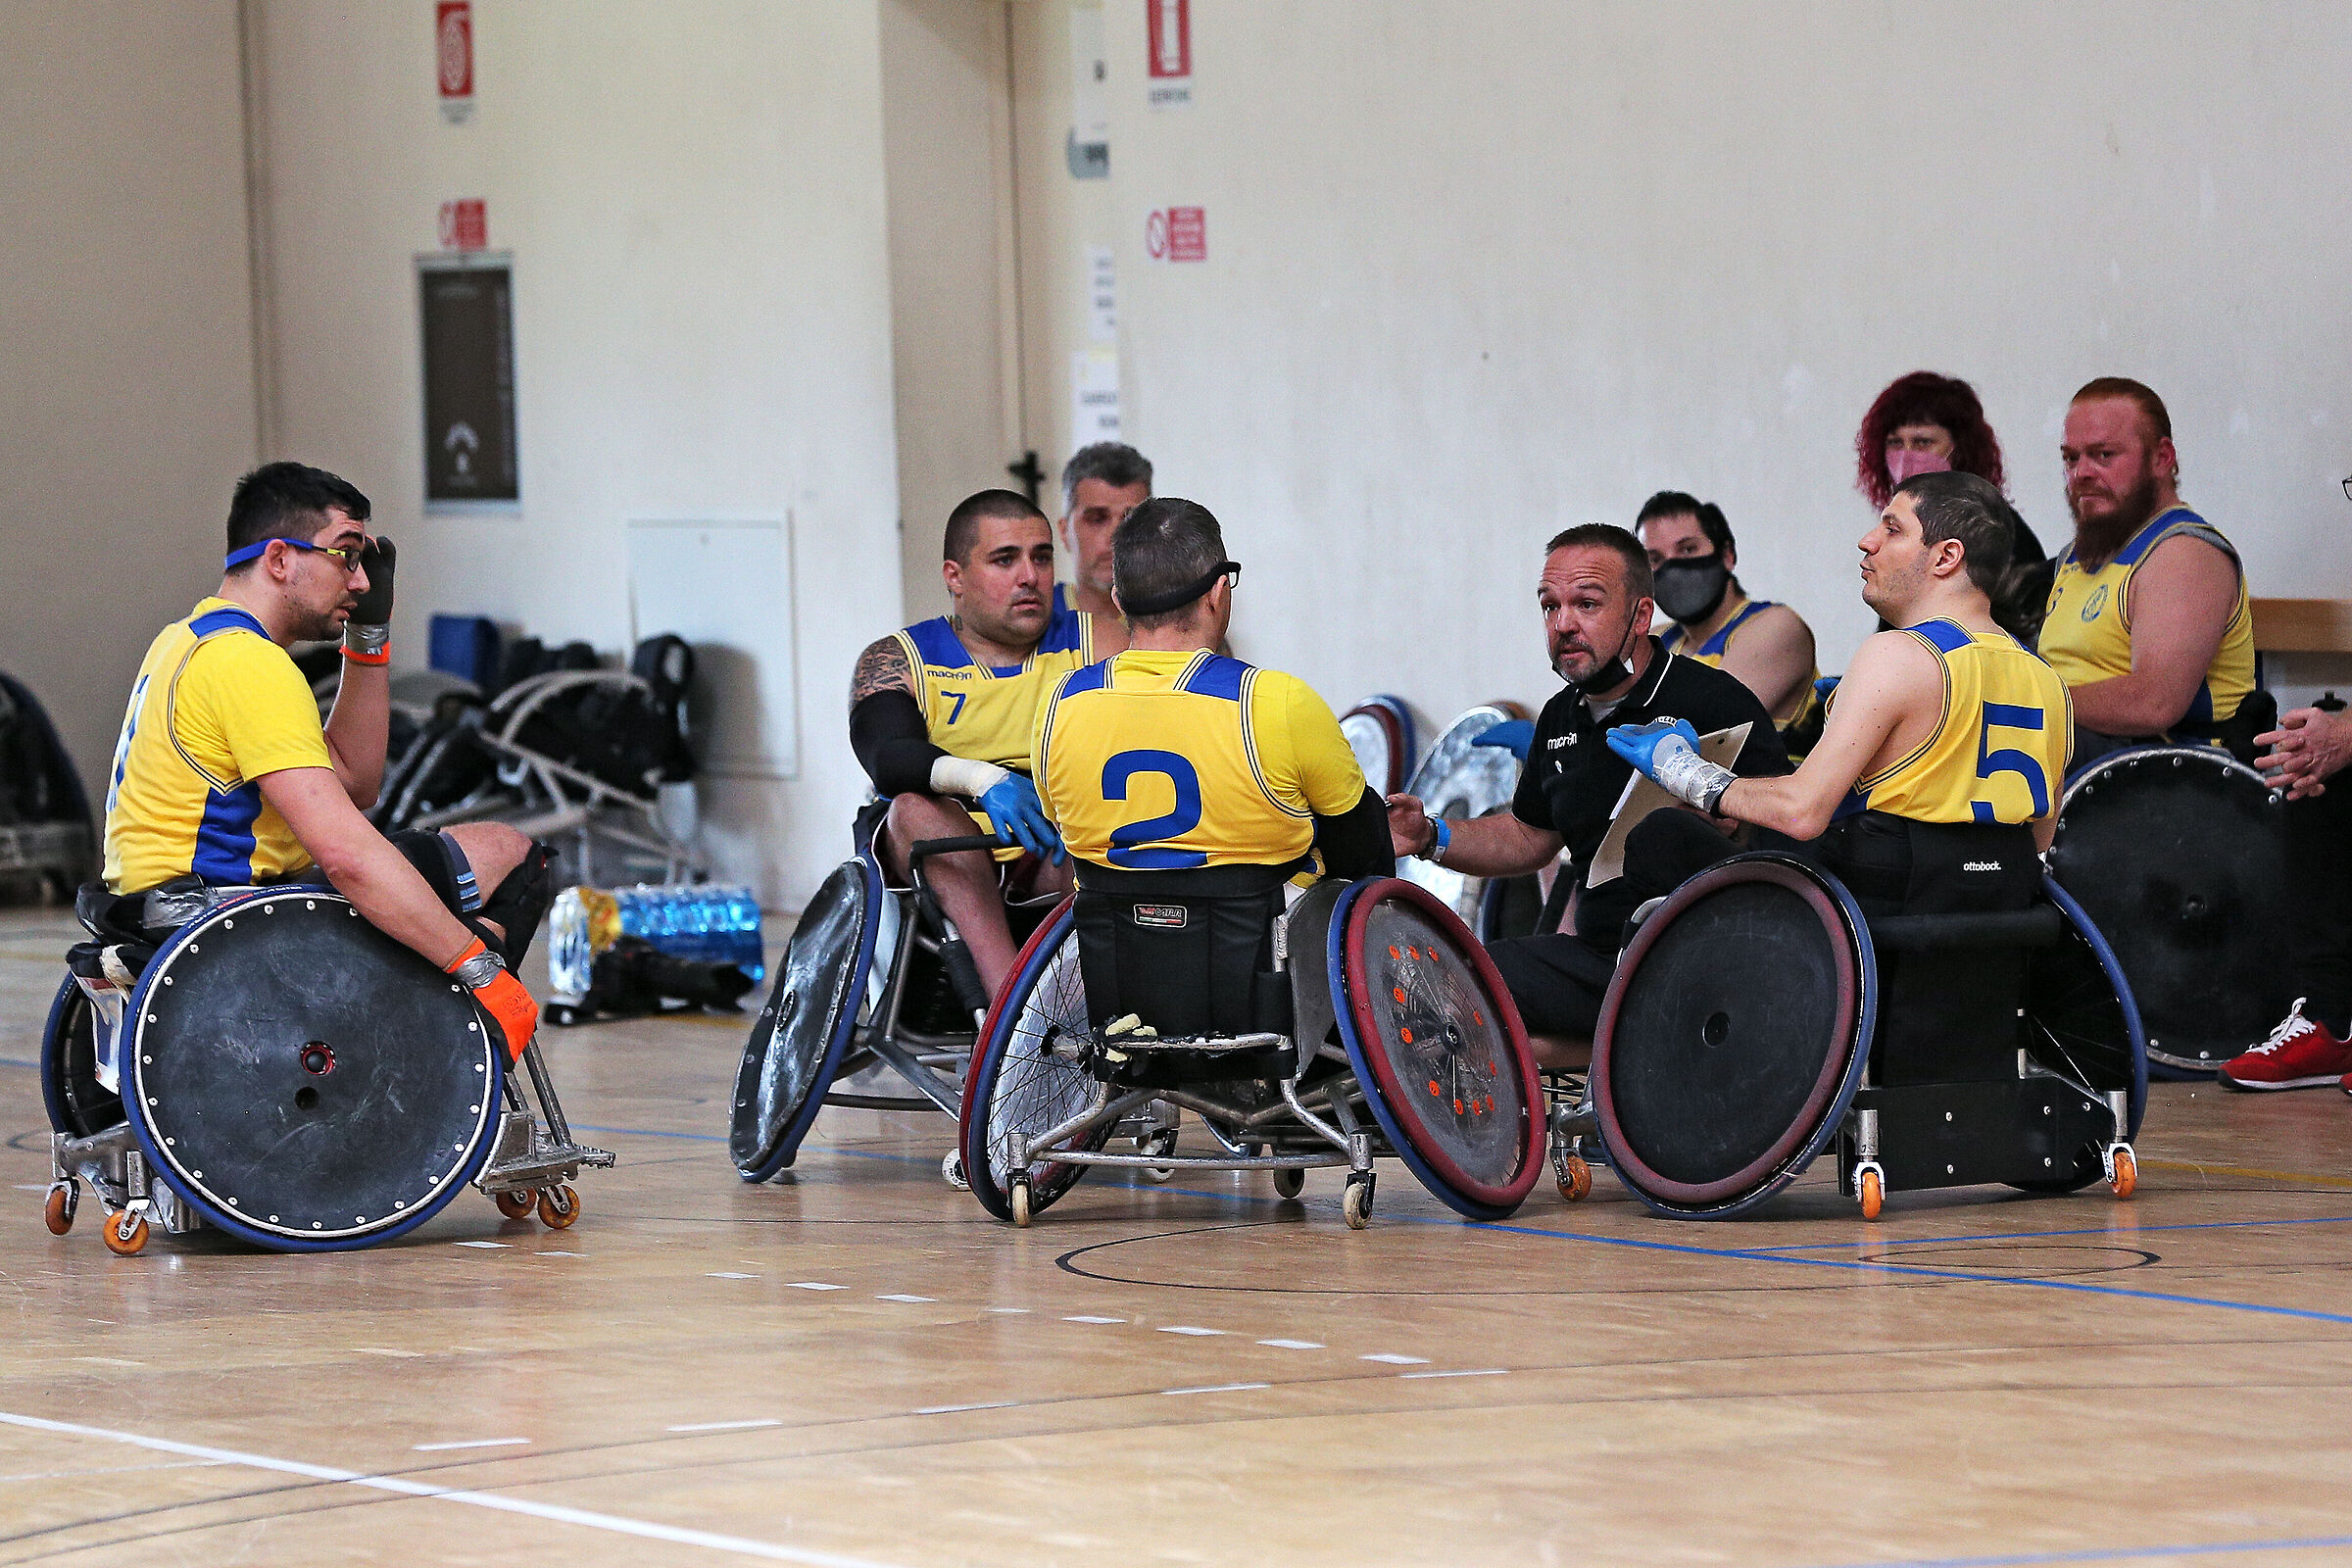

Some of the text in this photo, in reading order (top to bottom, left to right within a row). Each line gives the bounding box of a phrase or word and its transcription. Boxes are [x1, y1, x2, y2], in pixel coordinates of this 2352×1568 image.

[927, 670, 972, 680] macron
[941, 691, 966, 725] 7
[1547, 731, 1578, 750] macron
[1970, 700, 2050, 824] 5
[1102, 750, 1208, 869] 2
